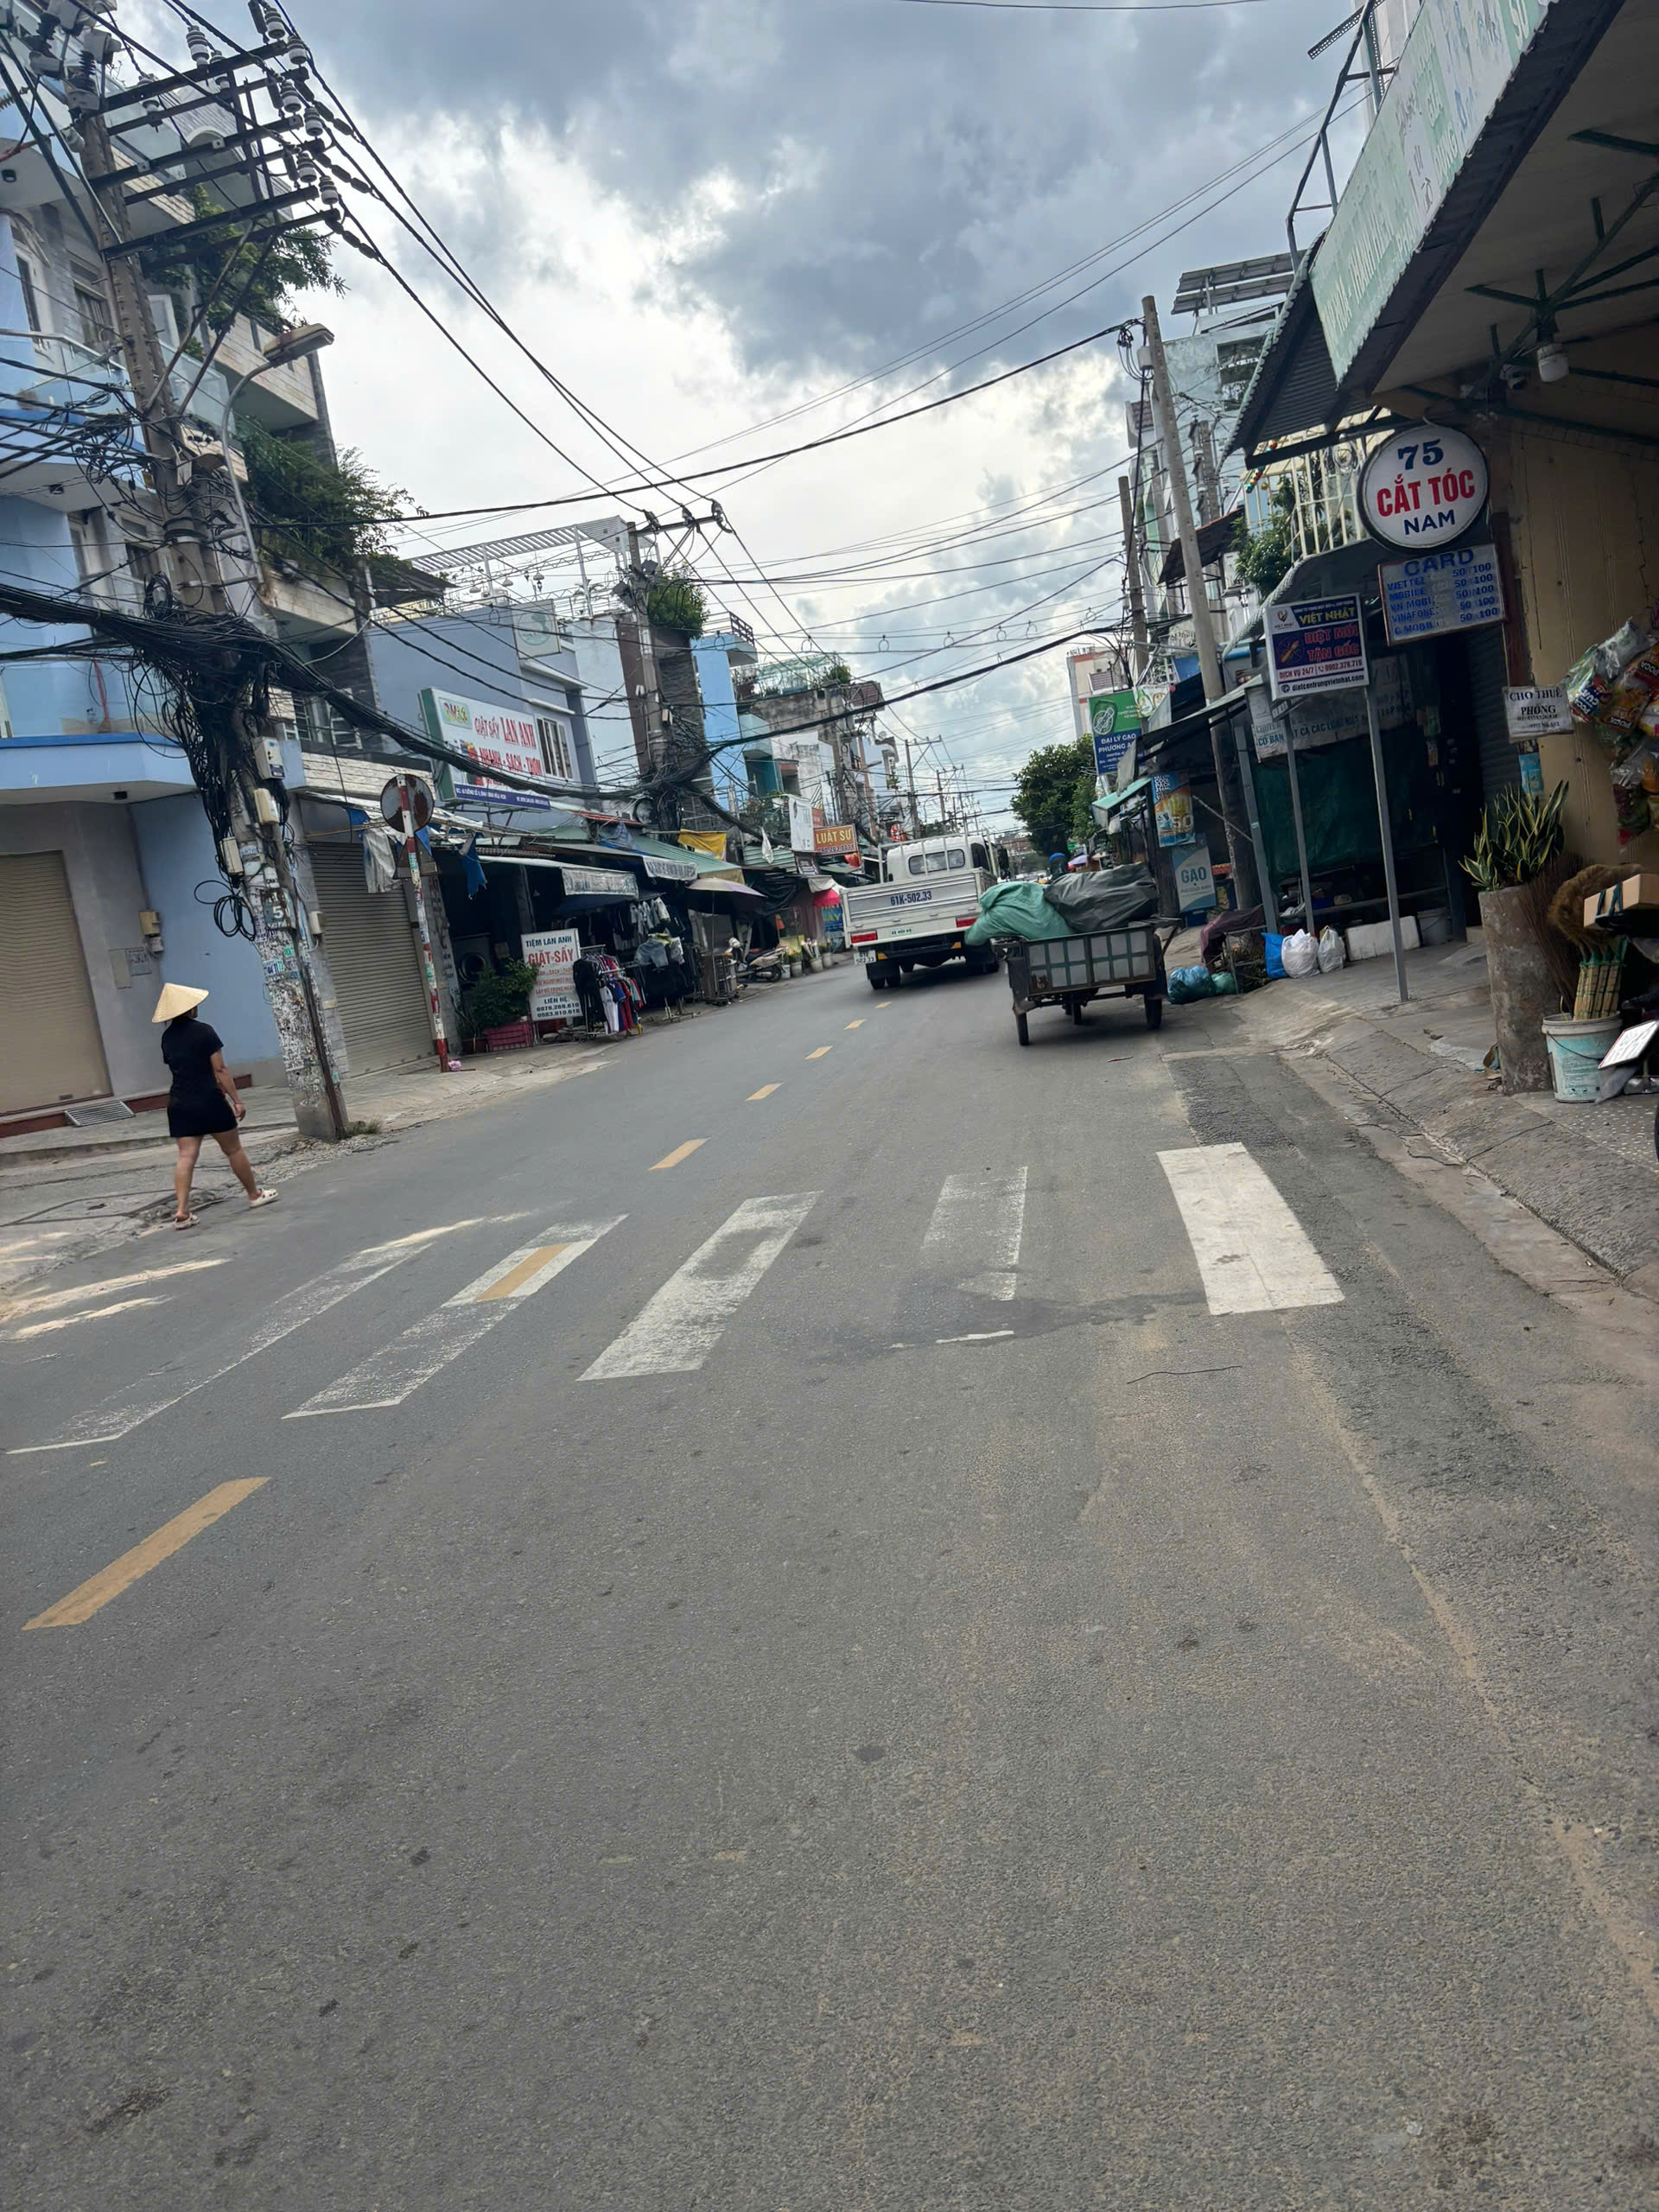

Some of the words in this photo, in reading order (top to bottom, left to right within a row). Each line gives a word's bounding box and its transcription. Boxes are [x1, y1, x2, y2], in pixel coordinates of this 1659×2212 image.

[1397, 439, 1444, 471] 75
[1377, 474, 1421, 518] CẮT
[1427, 467, 1475, 505] TÓC
[1404, 510, 1455, 536] NAM
[1404, 549, 1474, 576] CARD
[1510, 691, 1533, 702] CHO
[1535, 687, 1563, 699] THUÊ
[499, 716, 518, 745] LAN
[518, 720, 537, 750] ANH
[1181, 866, 1207, 886] GẠO
[890, 890, 932, 906] 61K-502.33
[272, 905, 284, 919] 5
[543, 937, 557, 946] LAN
[558, 935, 572, 944] ANH
